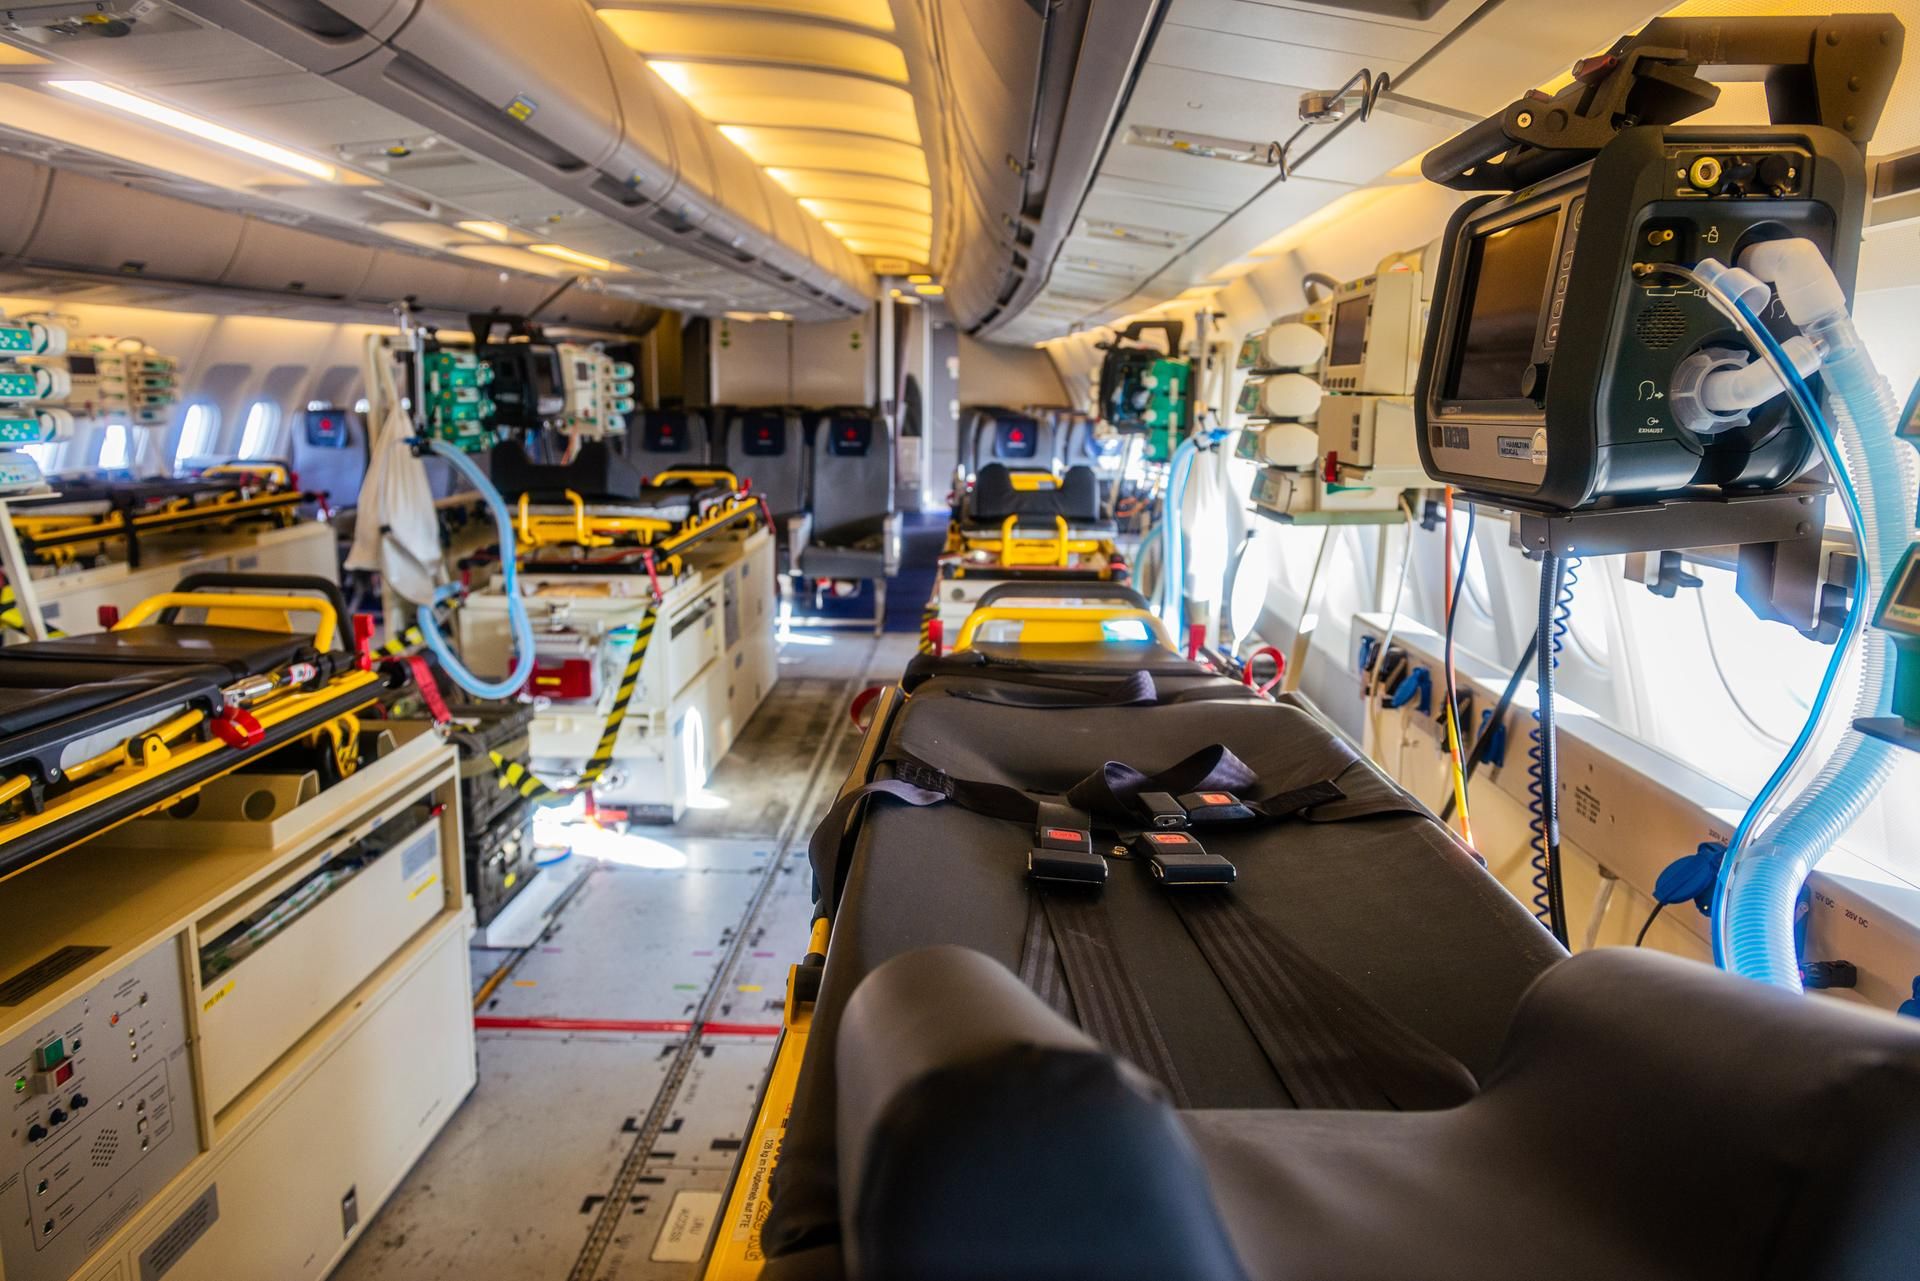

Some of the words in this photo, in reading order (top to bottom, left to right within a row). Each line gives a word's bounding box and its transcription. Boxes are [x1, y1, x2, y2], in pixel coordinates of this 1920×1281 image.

[1505, 440, 1530, 449] HAMILTON
[1501, 447, 1519, 456] MEDICAL
[1825, 897, 1835, 908] DC
[1858, 917, 1869, 928] DC
[760, 1149, 769, 1158] kg
[747, 1166, 767, 1201] Flugbetrieb
[744, 1201, 753, 1214] auf
[670, 1208, 690, 1243] ACCESS
[739, 1213, 752, 1229] PTE
